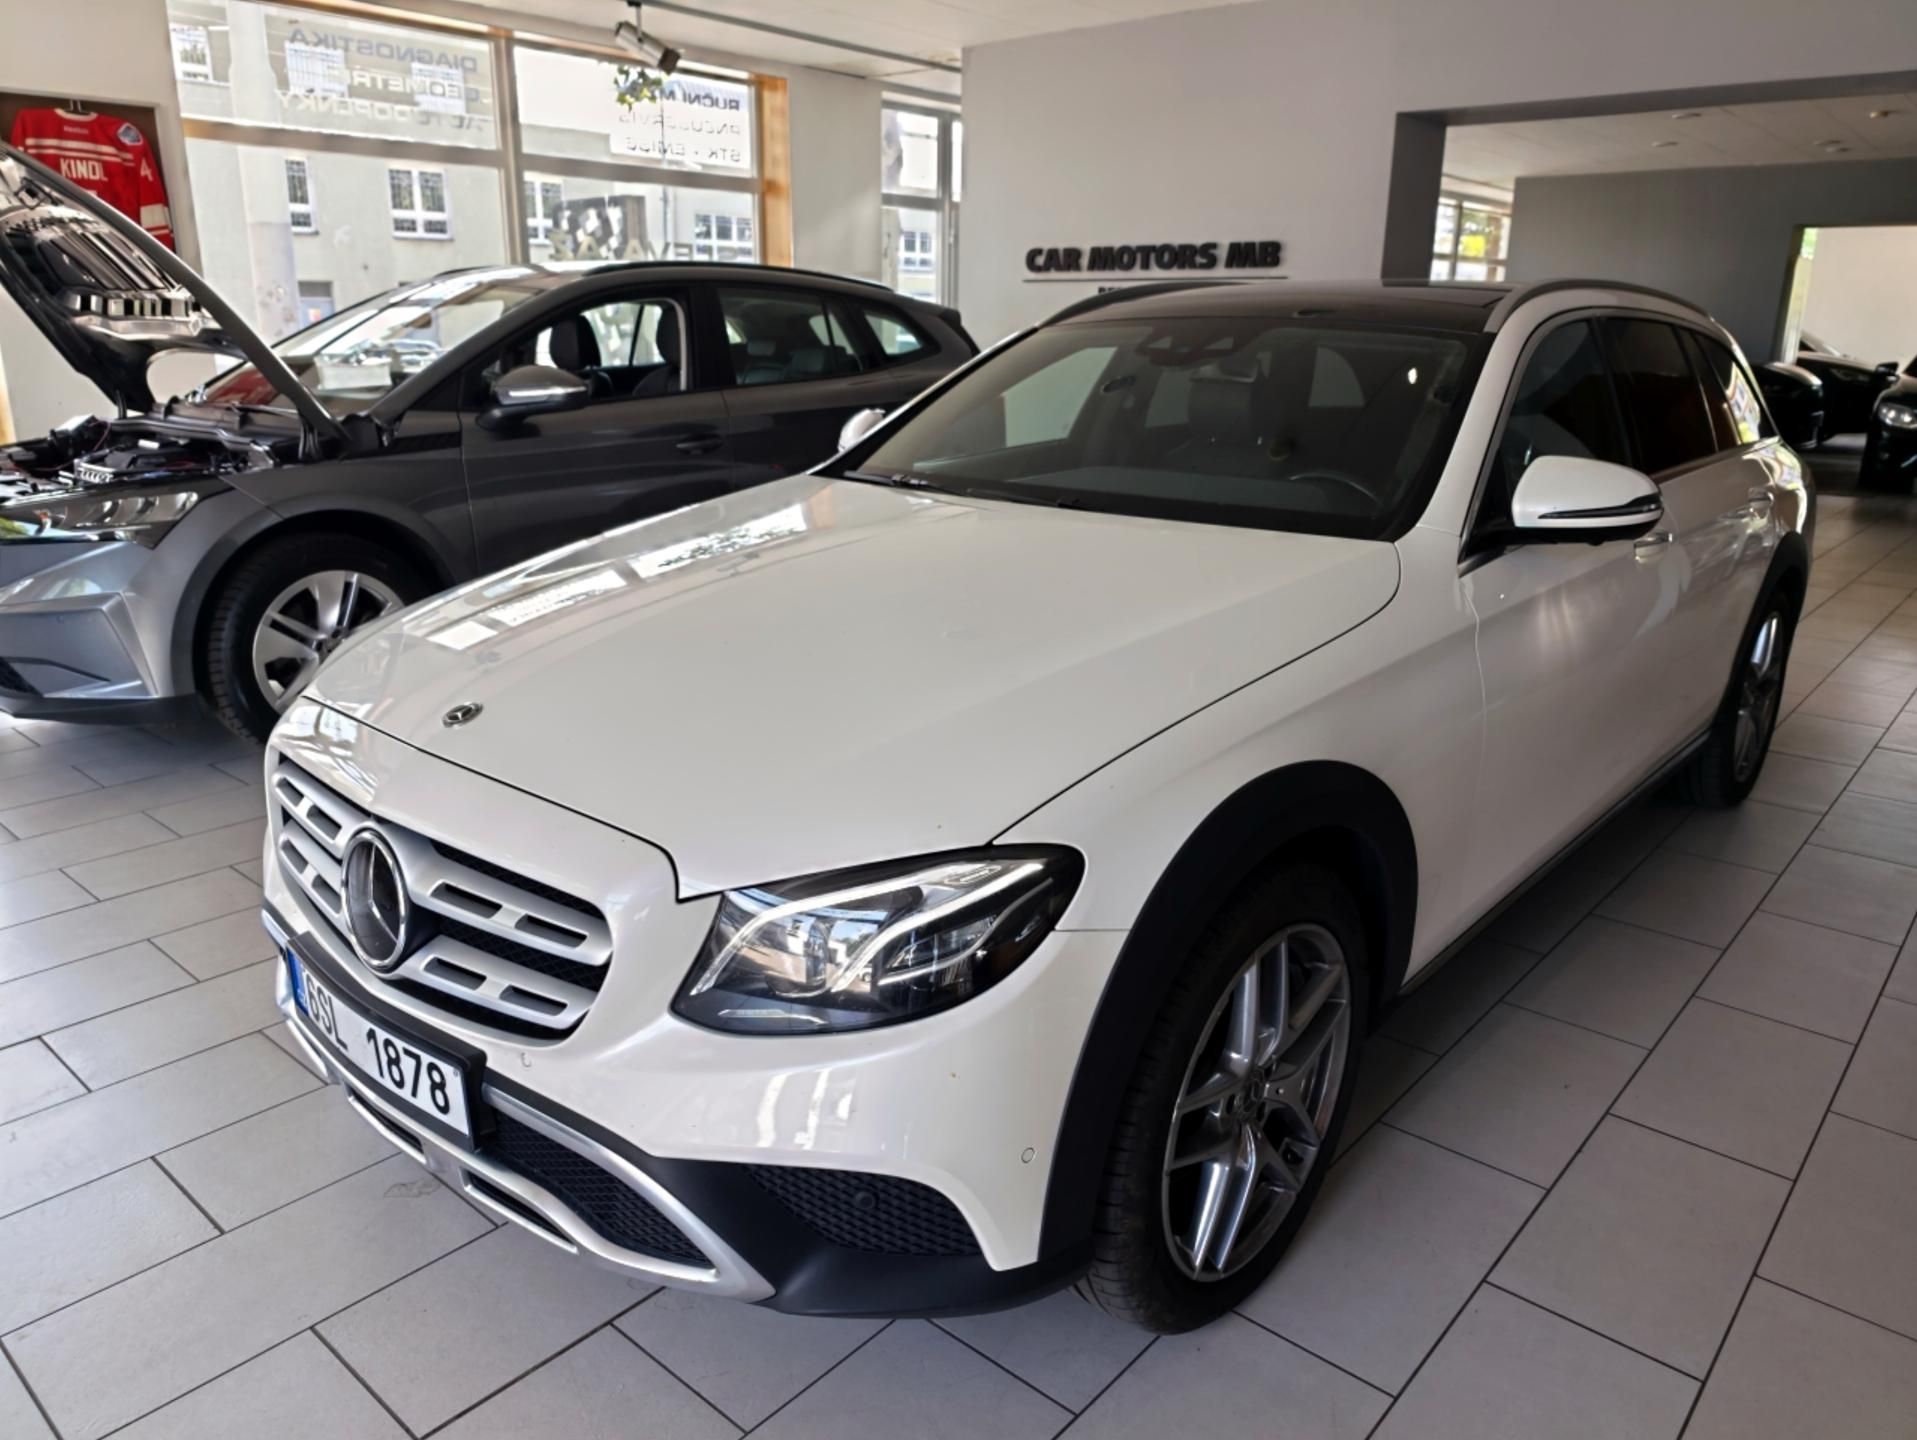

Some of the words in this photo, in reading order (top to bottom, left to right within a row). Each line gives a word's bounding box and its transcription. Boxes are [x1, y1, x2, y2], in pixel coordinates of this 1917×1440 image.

[60, 158, 108, 181] KINDL
[1026, 247, 1082, 273] CAR
[1087, 242, 1218, 272] MOTORS
[1224, 241, 1282, 268] MB
[306, 973, 348, 1051] 6SL
[366, 1028, 450, 1115] 1878
